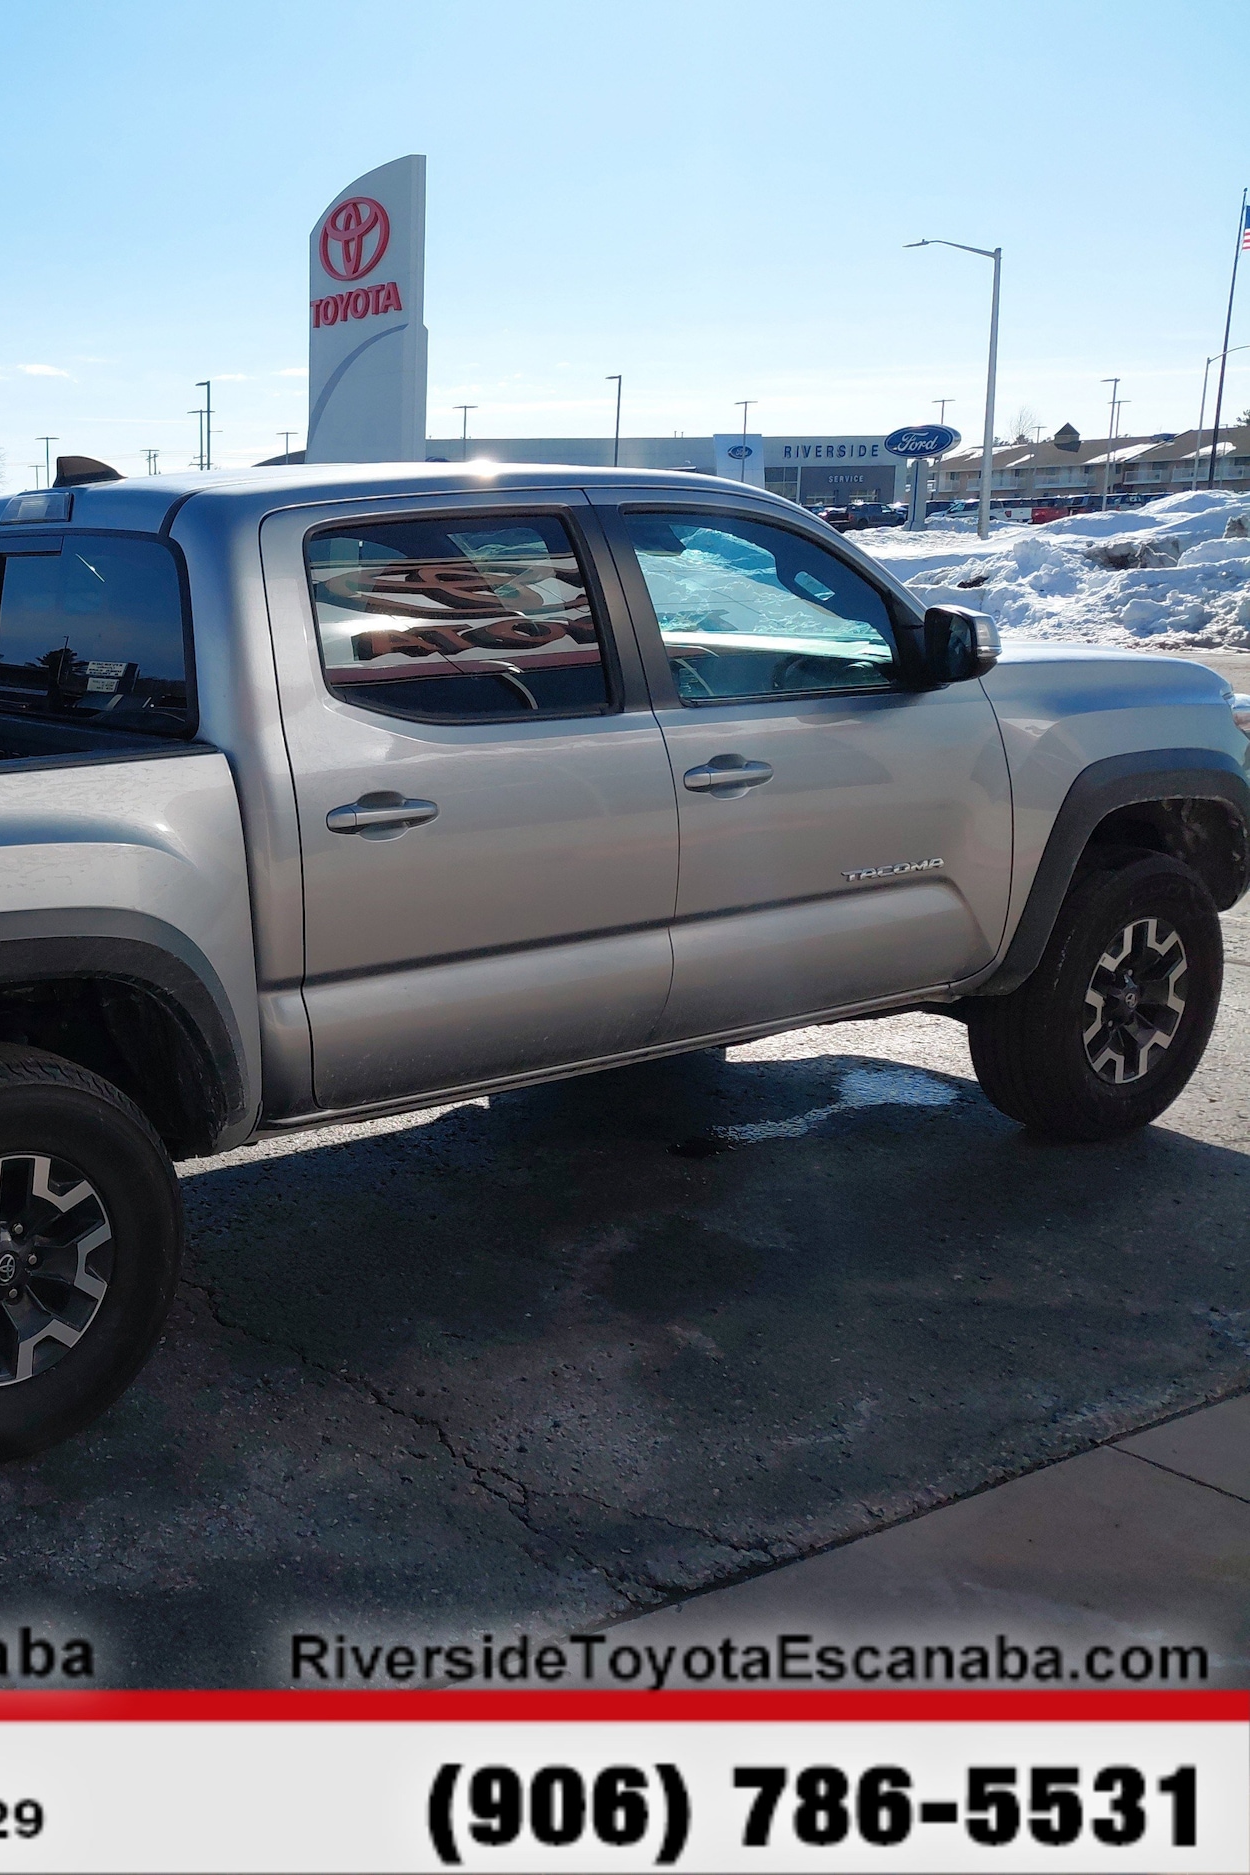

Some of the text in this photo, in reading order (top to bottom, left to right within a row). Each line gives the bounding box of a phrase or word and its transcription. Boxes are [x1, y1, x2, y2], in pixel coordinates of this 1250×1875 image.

[310, 282, 402, 328] TOYOTA
[784, 444, 879, 458] RIVERSIDE
[897, 432, 939, 451] Ford
[828, 475, 864, 483] SERVICE
[841, 857, 945, 882] TACOMA
